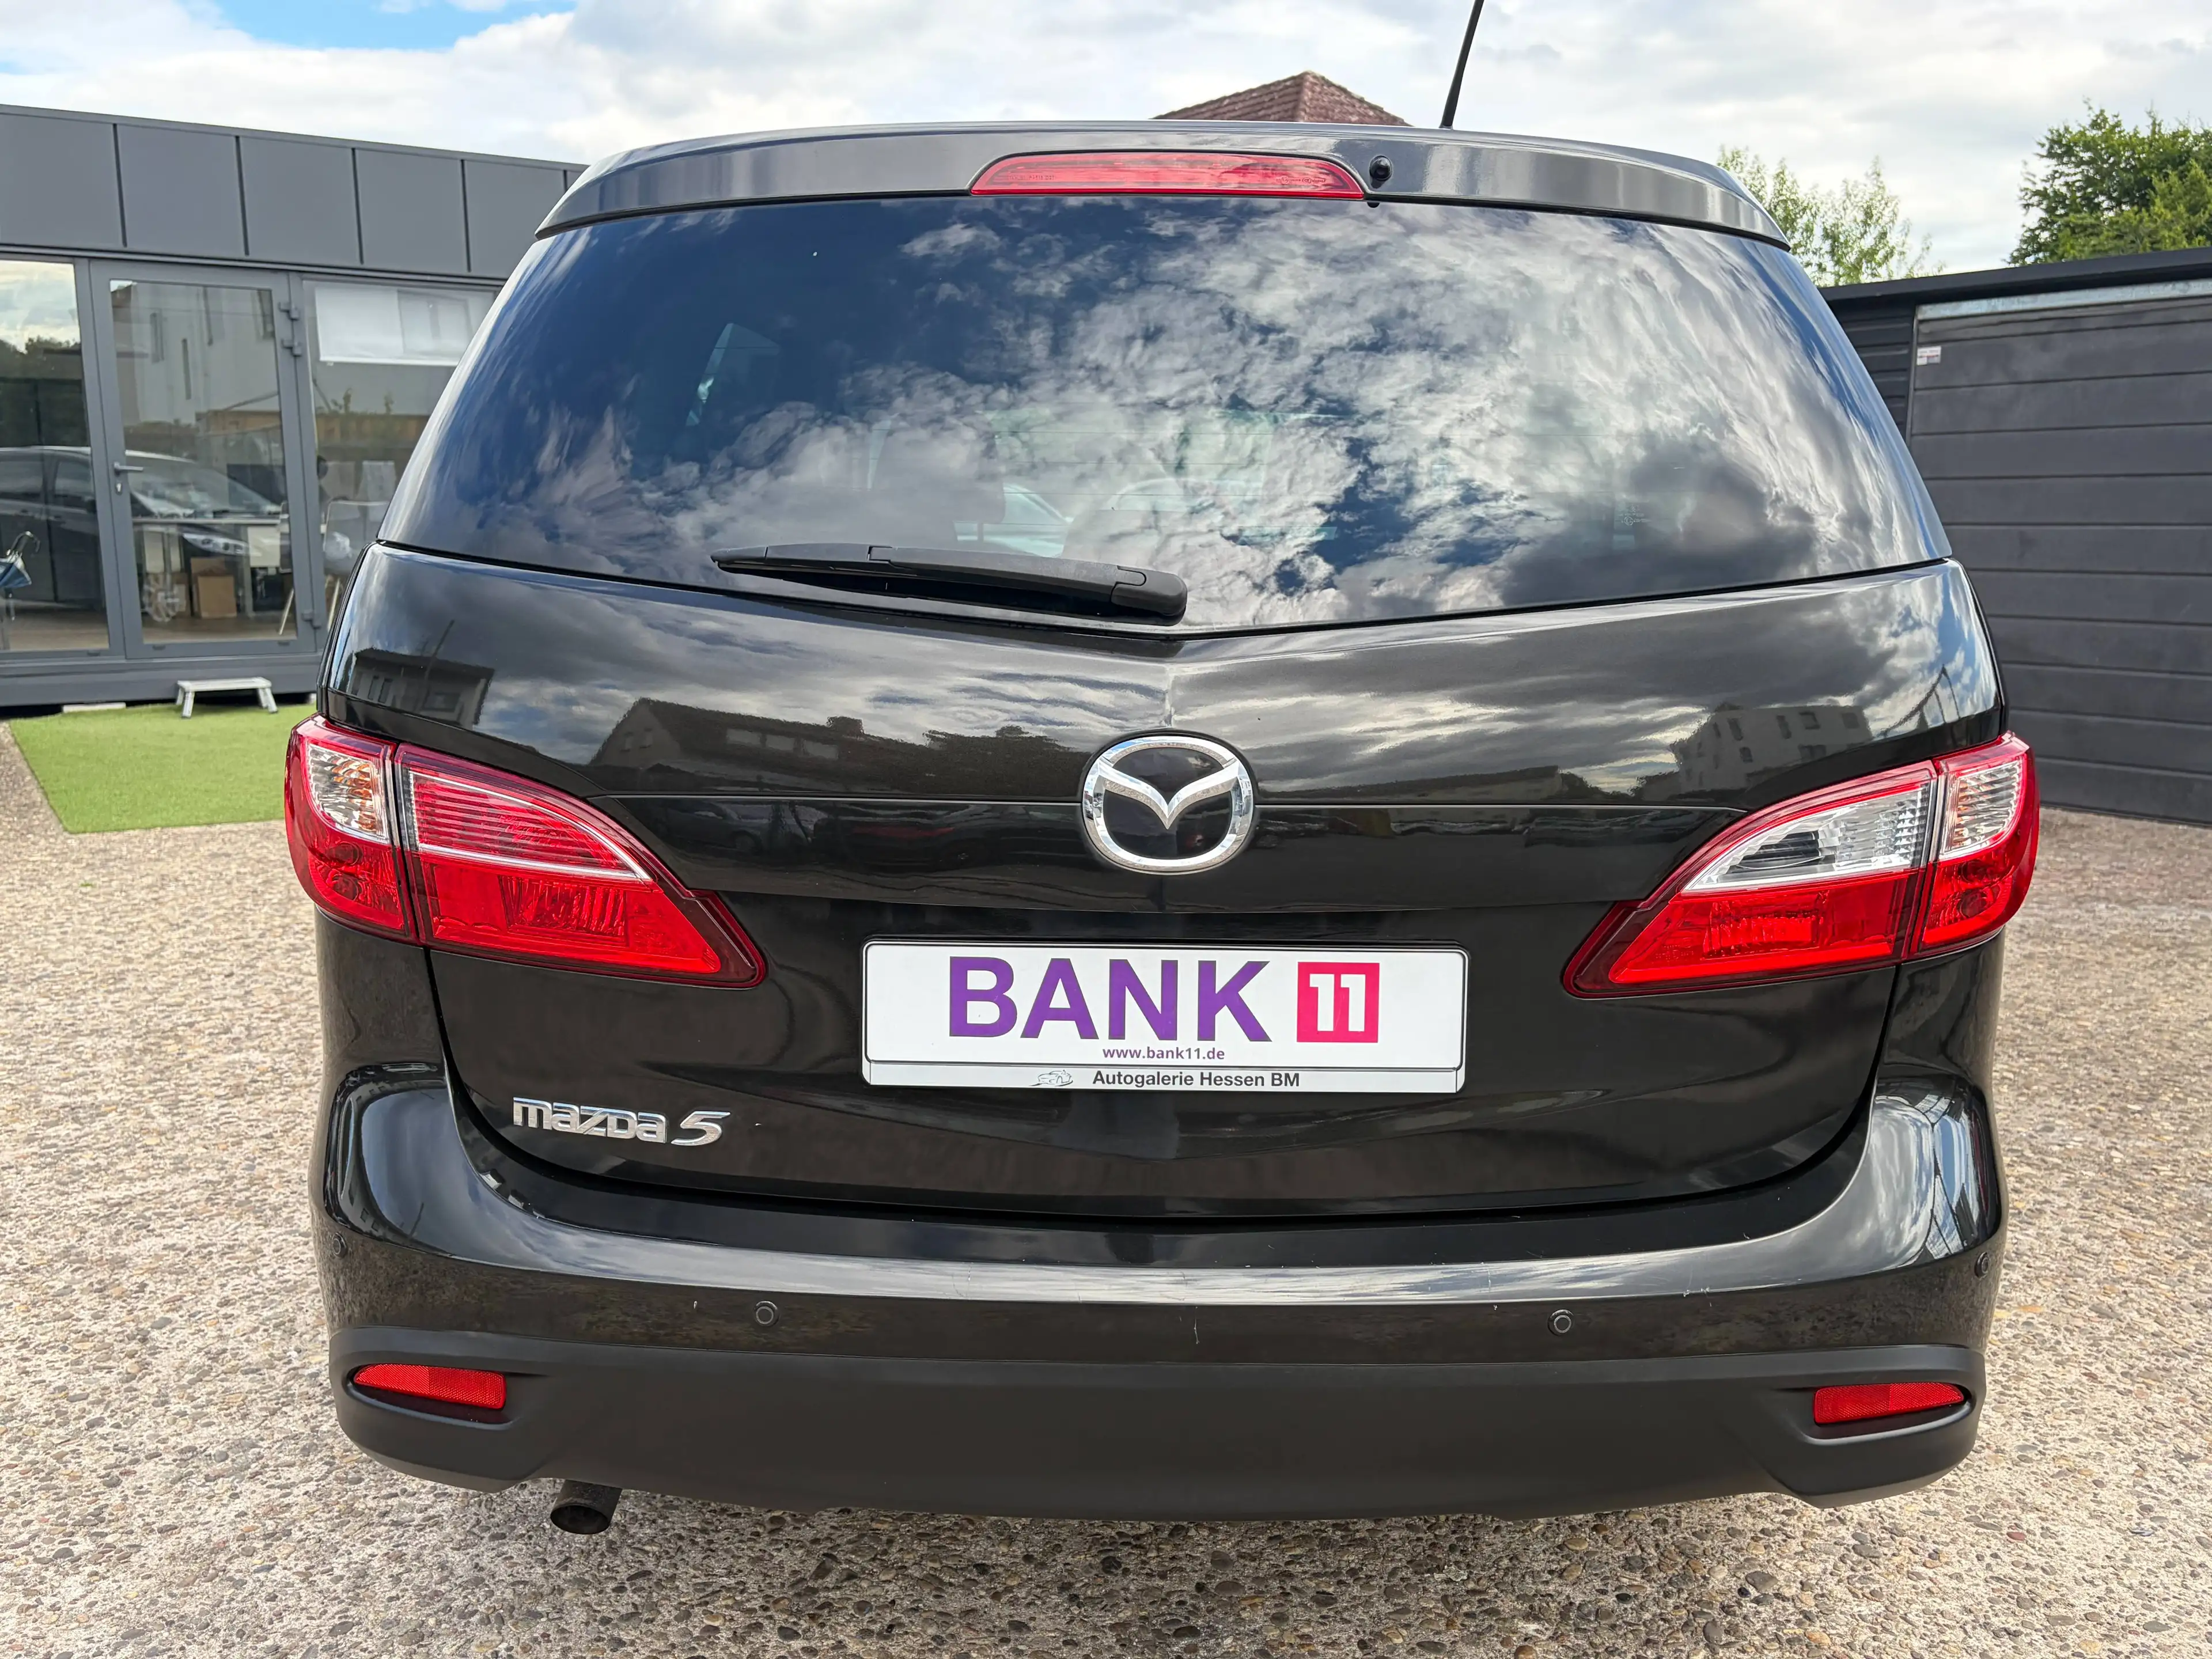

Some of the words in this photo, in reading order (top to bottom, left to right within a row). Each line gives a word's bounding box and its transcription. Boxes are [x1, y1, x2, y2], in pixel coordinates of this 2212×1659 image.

[949, 956, 1272, 1042] BANK
[1309, 973, 1366, 1032] 11
[1102, 1046, 1225, 1060] www.bank11.de
[1093, 1070, 1194, 1088] Autogalerie
[1200, 1071, 1265, 1086] Hessen
[1271, 1073, 1300, 1087] BM
[671, 1111, 731, 1146] 5
